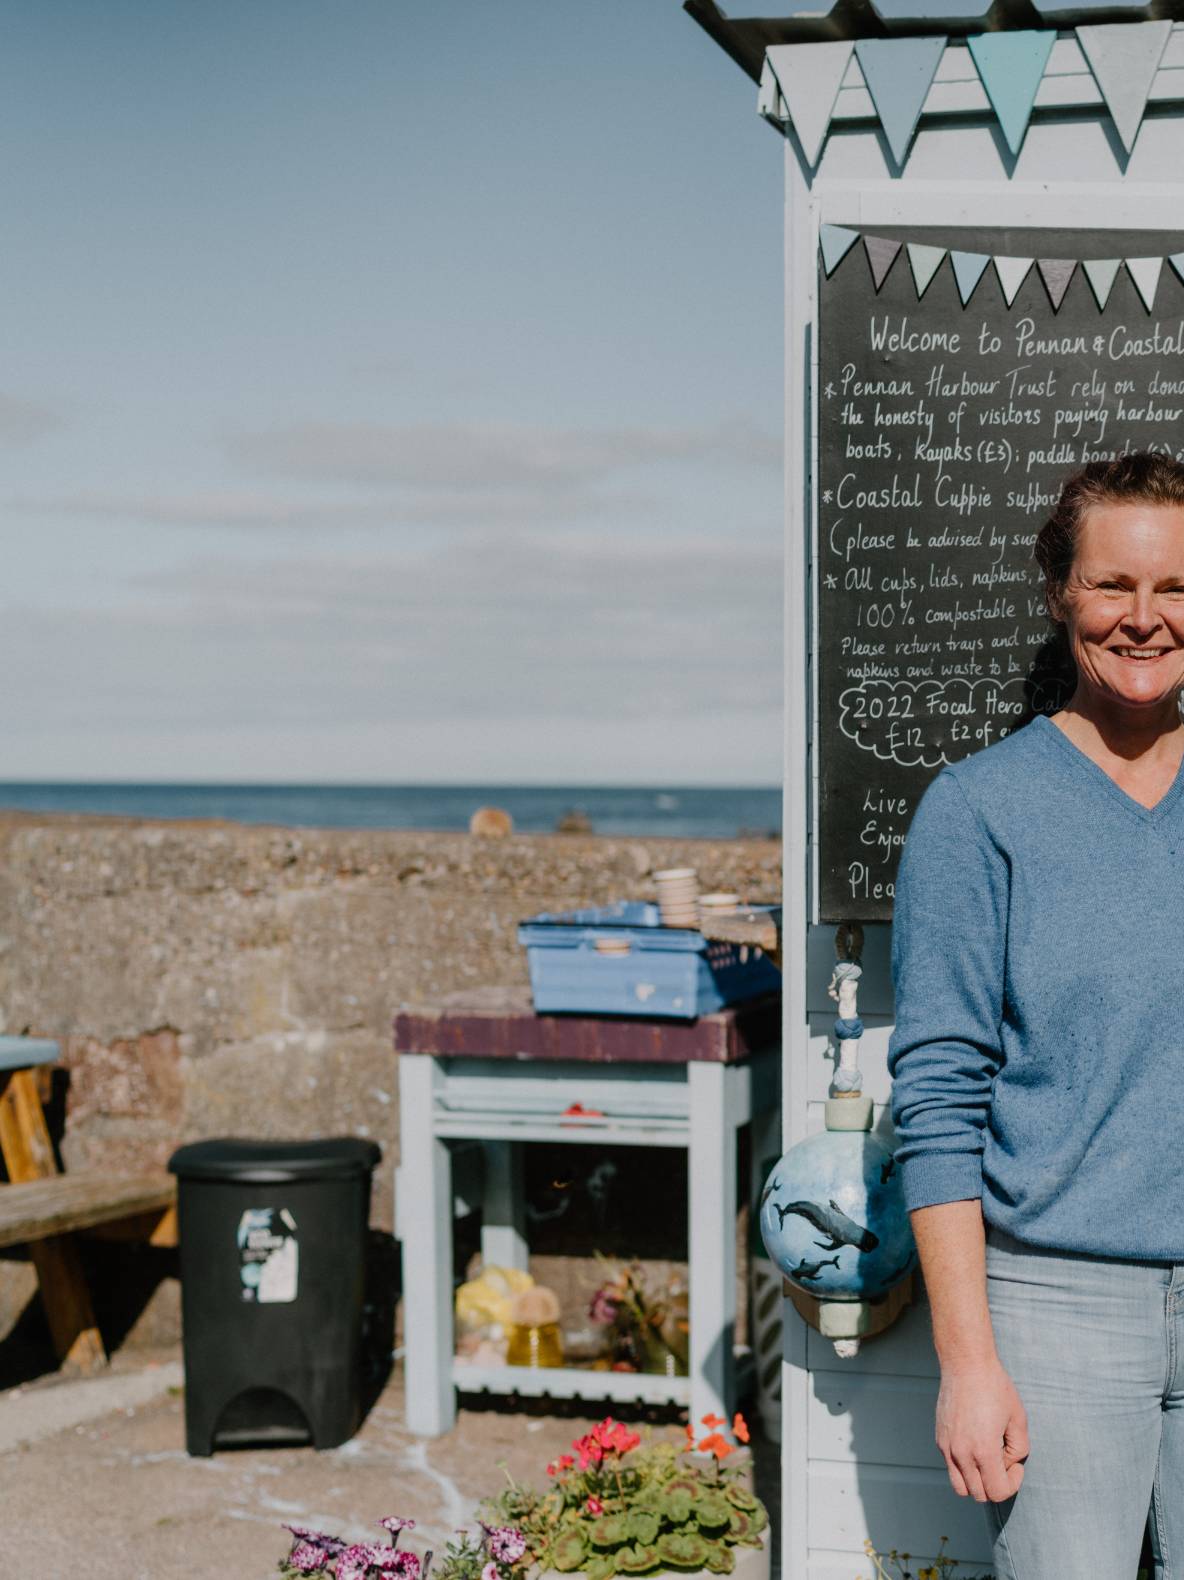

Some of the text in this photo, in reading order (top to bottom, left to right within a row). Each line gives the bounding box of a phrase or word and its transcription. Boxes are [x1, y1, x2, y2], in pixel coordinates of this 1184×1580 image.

[870, 315, 960, 353] Welcome
[978, 322, 1001, 355] to
[1016, 318, 1088, 357] Pennan
[1092, 336, 1105, 356] &
[841, 363, 914, 396] Pennan
[925, 364, 1000, 397] Harbour
[1005, 365, 1056, 399] Trust
[1071, 369, 1107, 405] rely
[1114, 380, 1136, 393] on
[841, 402, 864, 425] the
[874, 400, 934, 447] honesty
[948, 401, 967, 434] of
[979, 402, 1041, 425] visitors
[1054, 403, 1109, 444] paying
[1116, 400, 1183, 421] harbour
[1027, 443, 1076, 473] paddle
[837, 473, 922, 509] Coastal
[935, 475, 992, 515] Cuppie
[906, 526, 922, 548] be
[928, 526, 982, 547] advised
[989, 526, 1005, 564] by
[881, 568, 924, 604] cups,
[929, 563, 963, 589] lids,
[972, 565, 1032, 591] napkins,
[857, 600, 915, 628] 100%
[925, 599, 1016, 630] compostable
[841, 636, 886, 656] Please
[895, 635, 942, 655] return
[946, 632, 984, 656] trays
[991, 627, 1020, 648] and
[847, 662, 900, 684] napkins
[906, 659, 934, 677] and
[941, 660, 983, 677] waste
[989, 660, 1001, 675] to
[1008, 655, 1021, 673] be
[853, 697, 915, 719] 2022
[926, 691, 976, 715] Focal
[986, 689, 1023, 715] Hero
[886, 722, 925, 749] £12
[976, 721, 993, 747] of
[863, 788, 908, 815] Live
